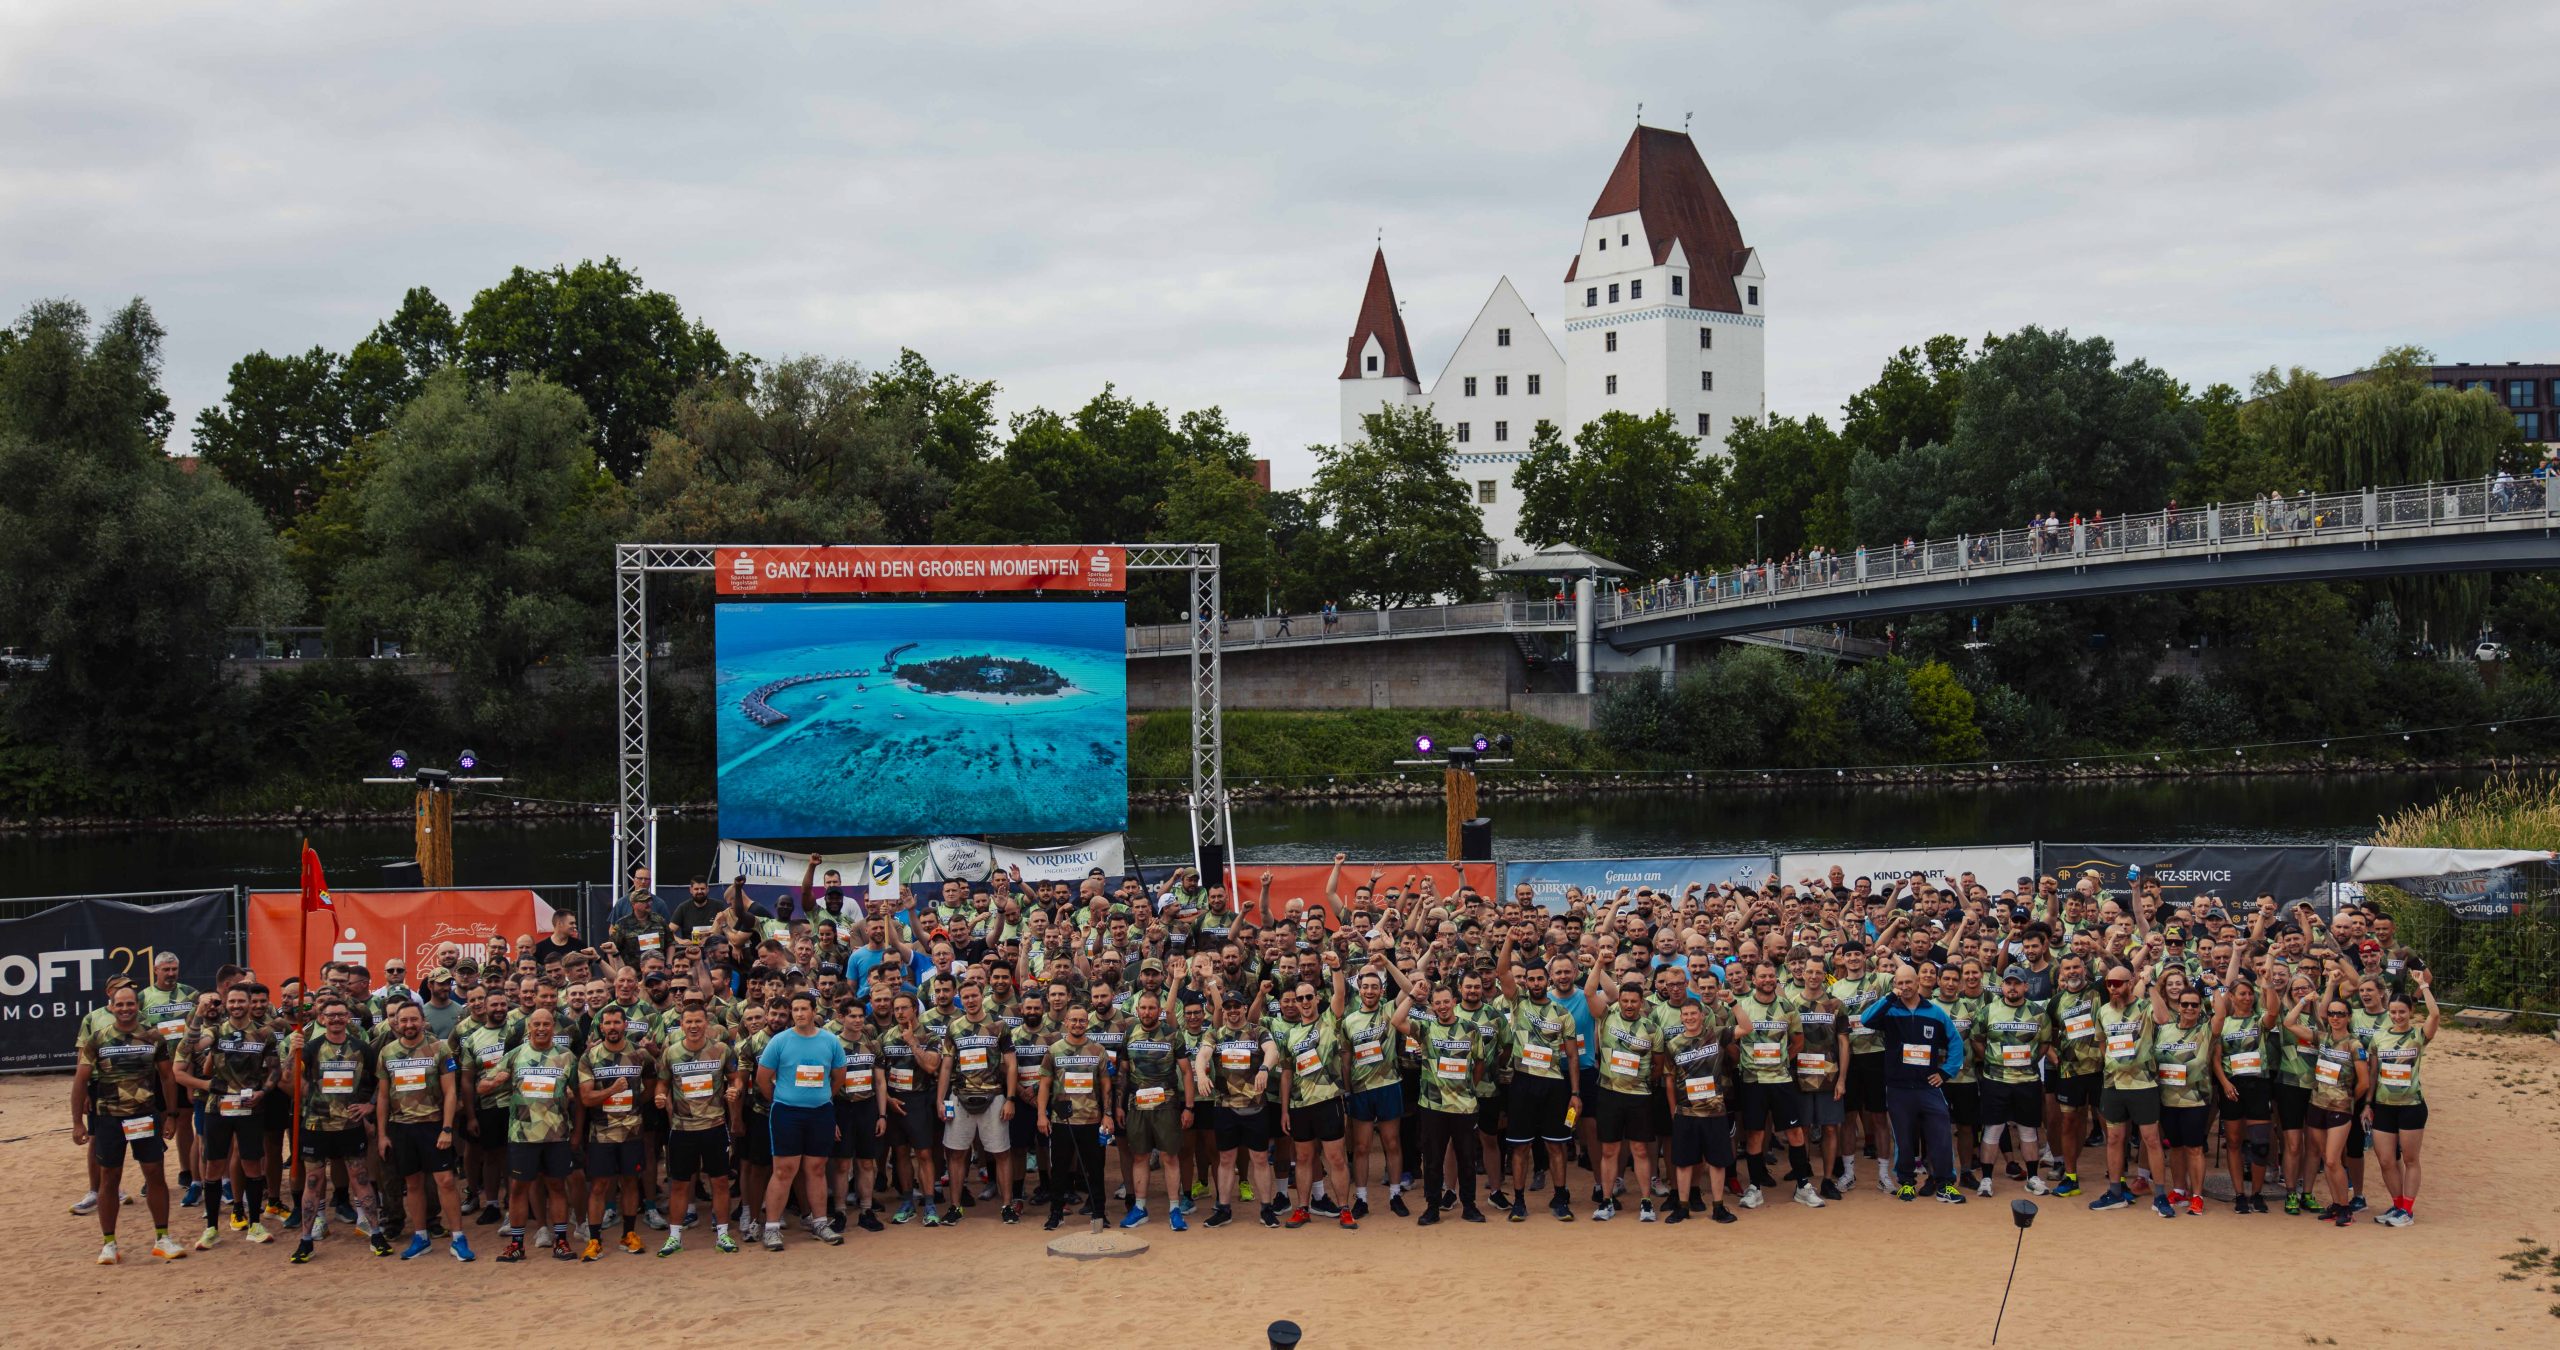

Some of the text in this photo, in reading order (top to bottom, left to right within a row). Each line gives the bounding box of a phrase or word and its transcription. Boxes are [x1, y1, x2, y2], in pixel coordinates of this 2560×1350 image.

[765, 559, 1079, 578] GANZ NAH AN DEN GROßEN MOMENTEN
[736, 845, 785, 864] JESUITEN
[1026, 851, 1098, 867] NORDBRÄU
[738, 862, 782, 877] QUELLE
[1873, 872, 1901, 881] KIND
[1922, 869, 1946, 879] ART.
[1605, 870, 1661, 884] Genuss am
[2154, 870, 2231, 882] KFZ-SERVICE
[1994, 1023, 2036, 1031] SPORTKAMERAD
[388, 1059, 433, 1069] SPORTKAMERAD
[674, 1062, 720, 1072] SPORTKAMERAD
[1057, 1057, 1099, 1065] SPORTKAMERAD
[519, 1067, 563, 1076] SPORTKAMERAD
[595, 1066, 641, 1076] SPORTKAMERAD
